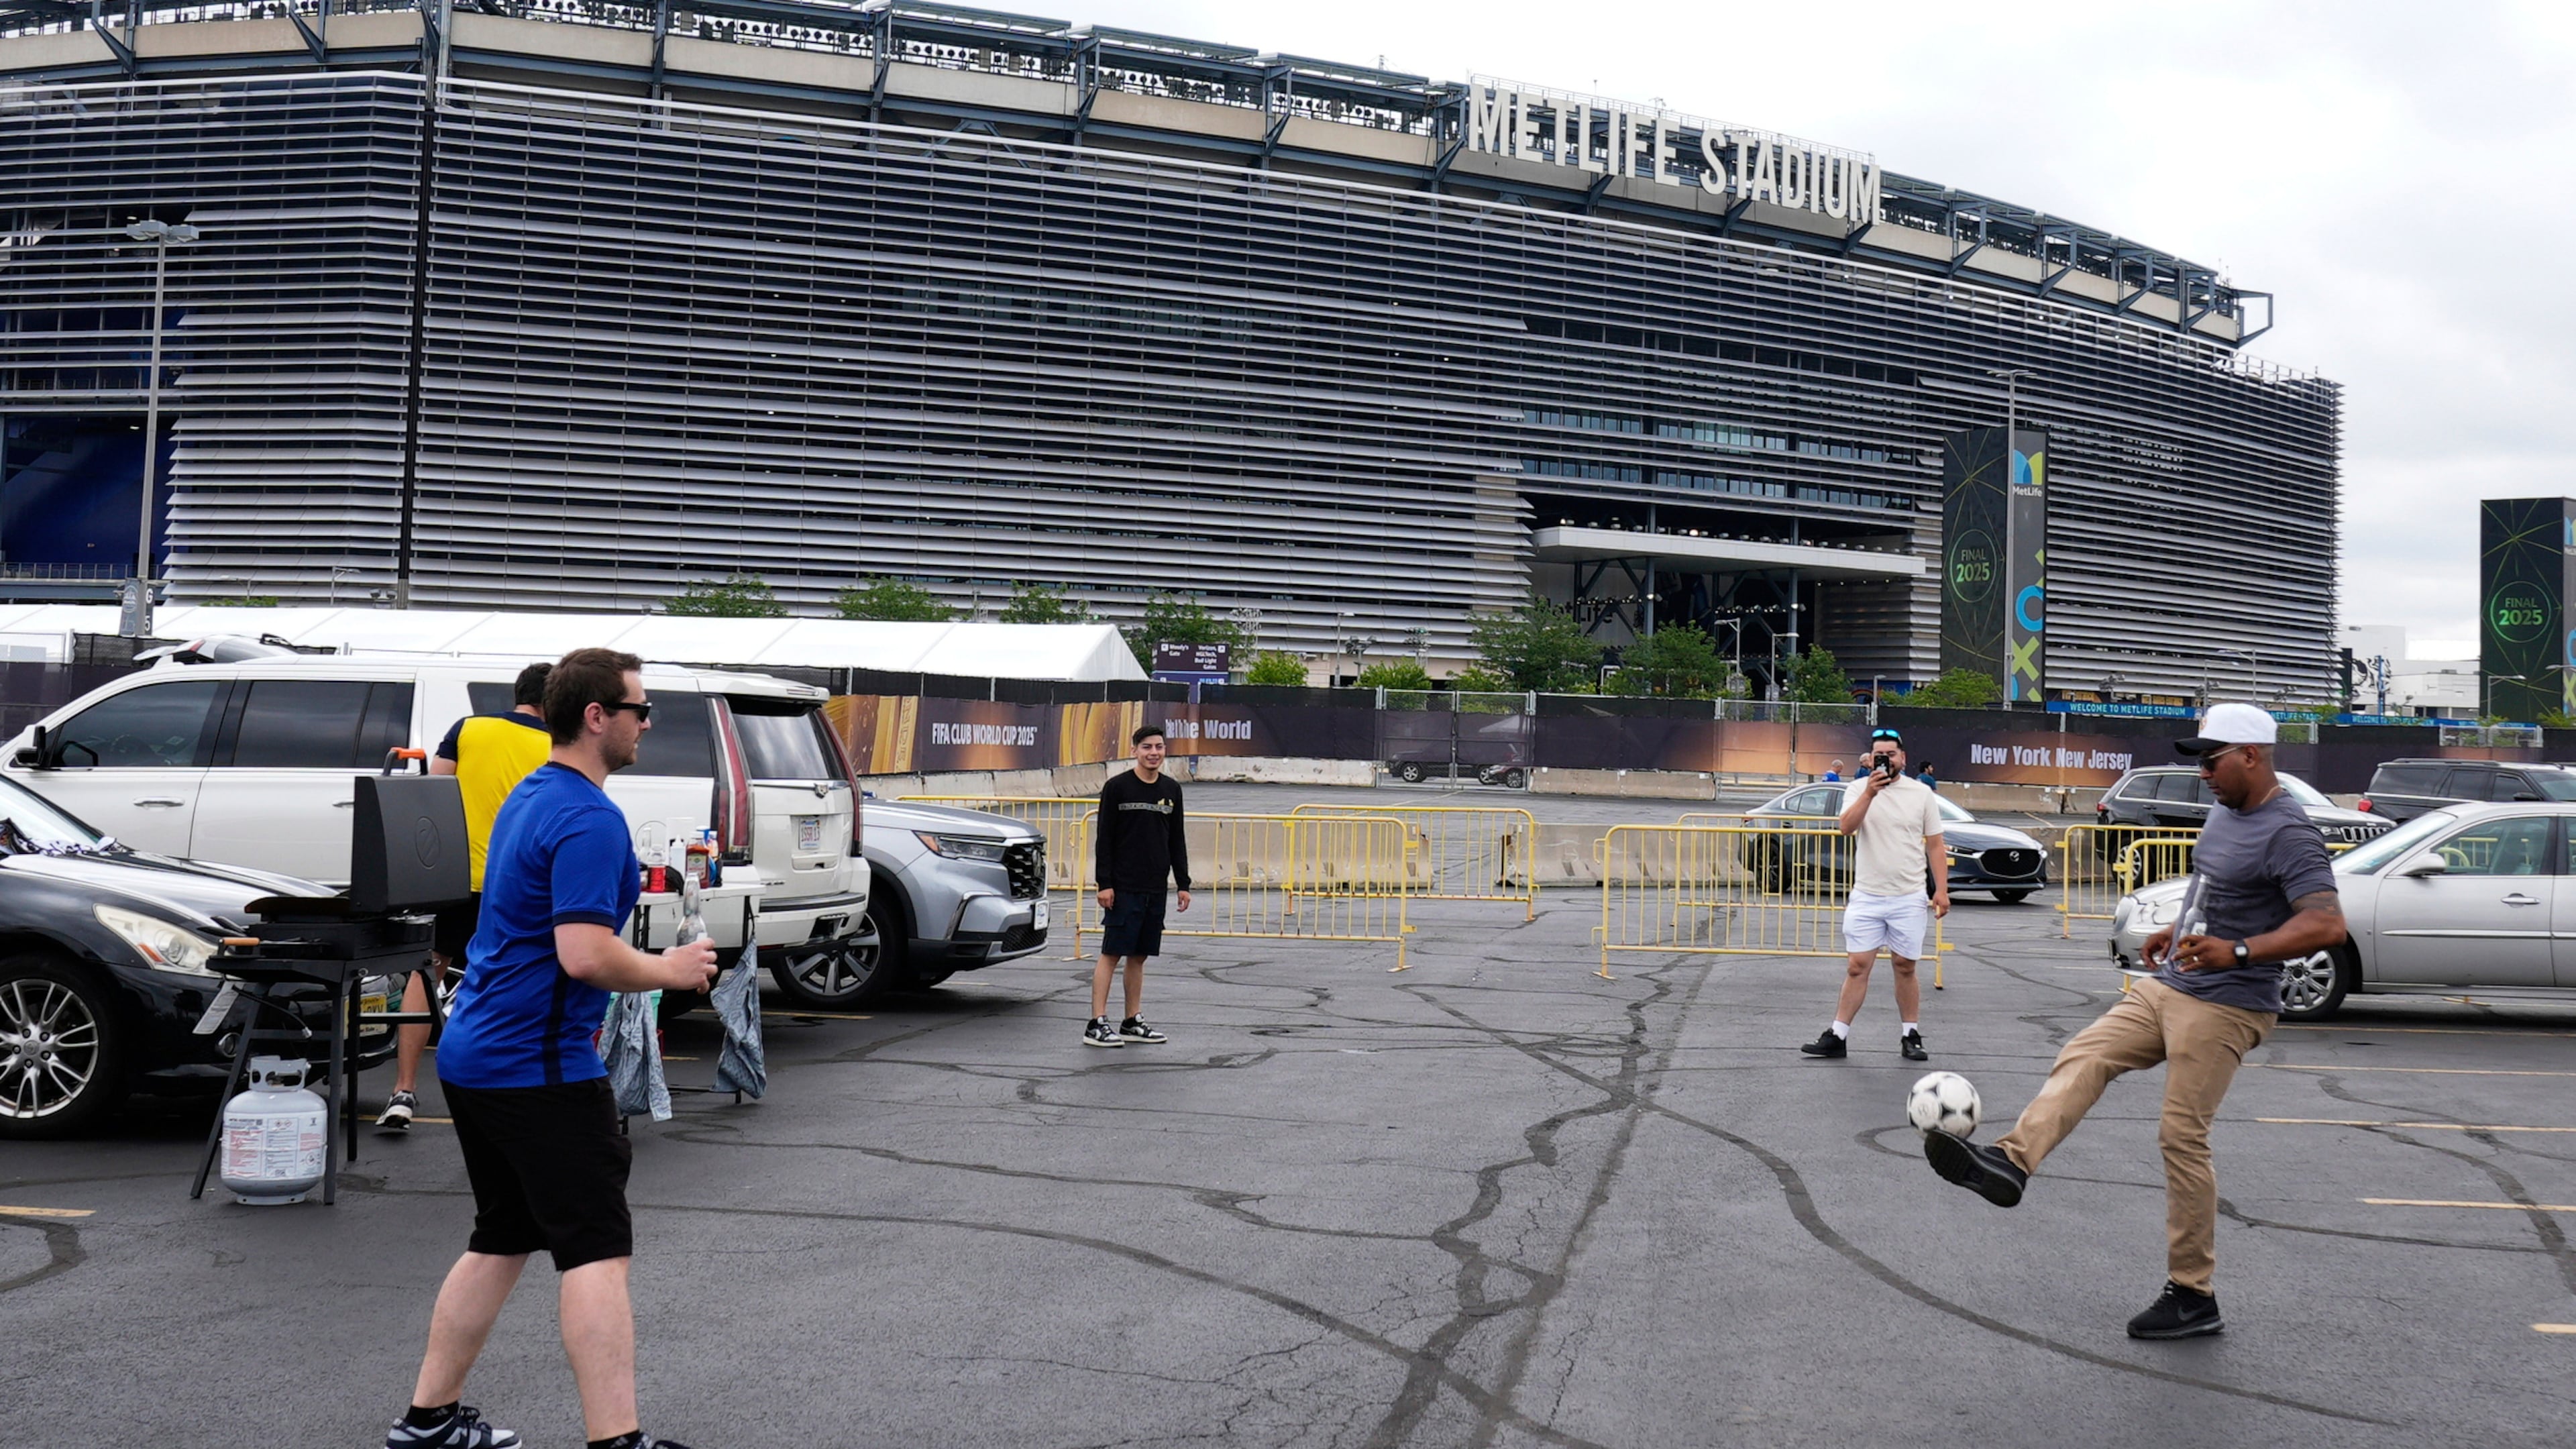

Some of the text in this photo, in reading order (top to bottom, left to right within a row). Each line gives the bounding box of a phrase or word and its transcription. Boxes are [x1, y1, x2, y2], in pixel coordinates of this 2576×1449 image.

[1468, 83, 1880, 226] METLIFE STADIUM
[2012, 486, 2043, 497] MetLife
[1961, 549, 1986, 561] FINAL
[1956, 562, 1990, 582] 2025
[146, 588, 154, 604] G
[2505, 598, 2538, 608] FINAL
[2499, 609, 2543, 625] 2025
[2070, 703, 2186, 716] WELCOME TO METLIFE STADIUM
[932, 722, 950, 745] FIFA
[951, 723, 971, 745] CLUB
[973, 724, 1002, 745] WORLD
[1002, 724, 1018, 746] CUP
[1203, 719, 1252, 739] World
[1971, 743, 2133, 771] New York New Jersey
